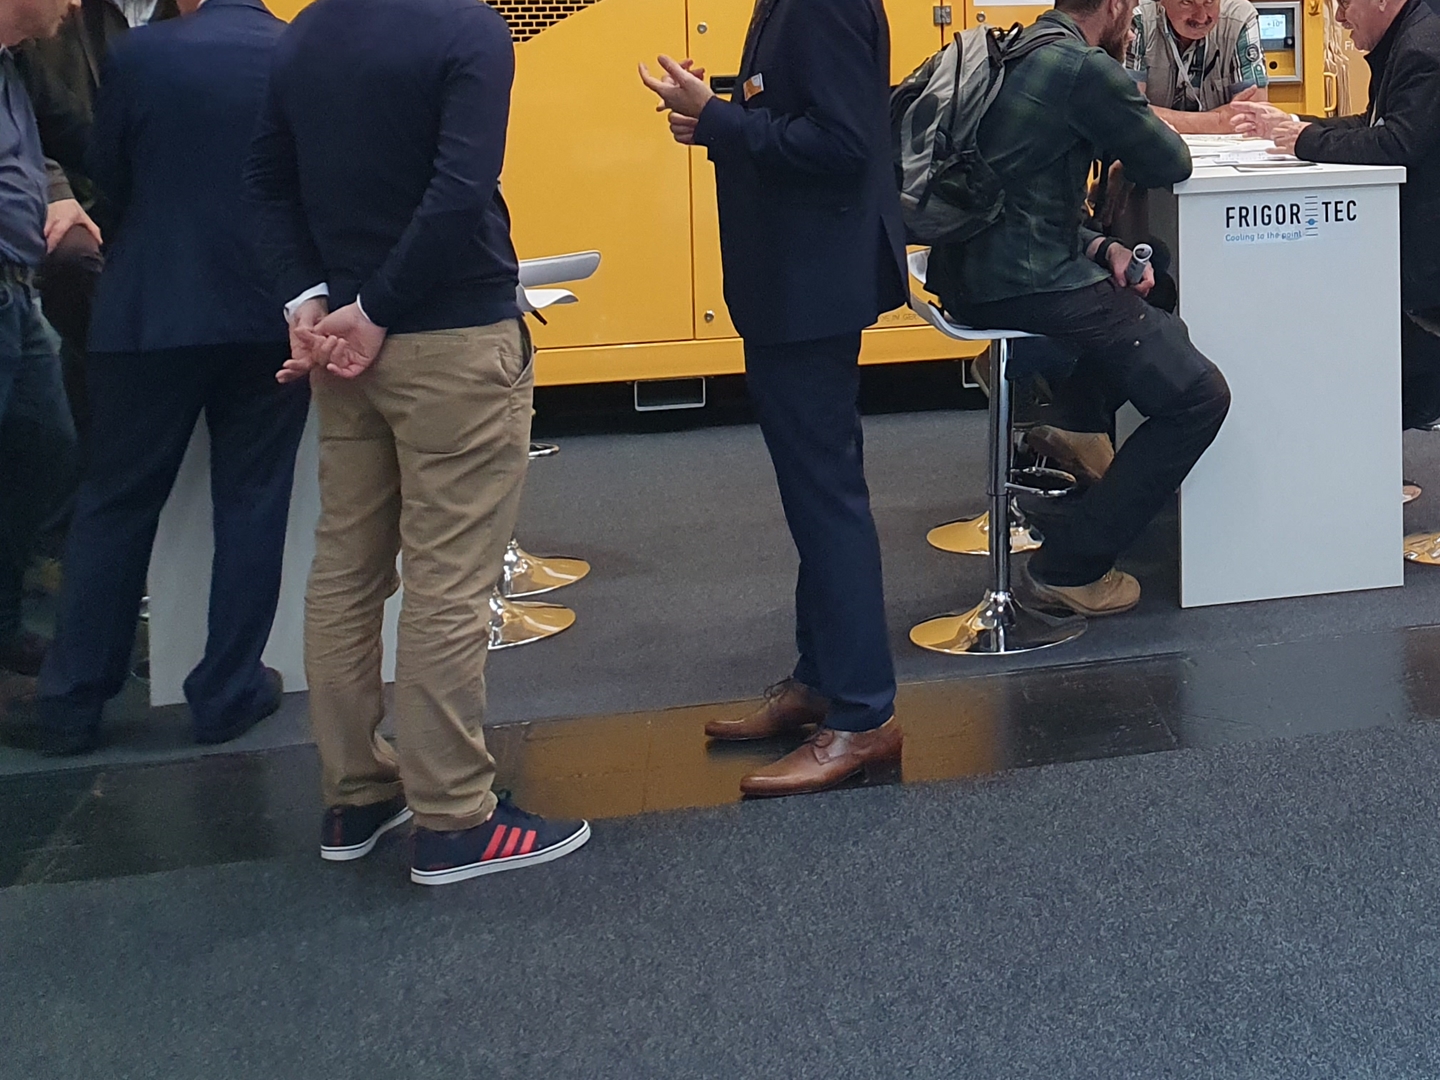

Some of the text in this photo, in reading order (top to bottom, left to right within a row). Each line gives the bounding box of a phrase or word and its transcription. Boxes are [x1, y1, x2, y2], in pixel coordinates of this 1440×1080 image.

[1225, 233, 1255, 243] Cooling
[1267, 231, 1280, 240] the
[1281, 230, 1302, 241] point
